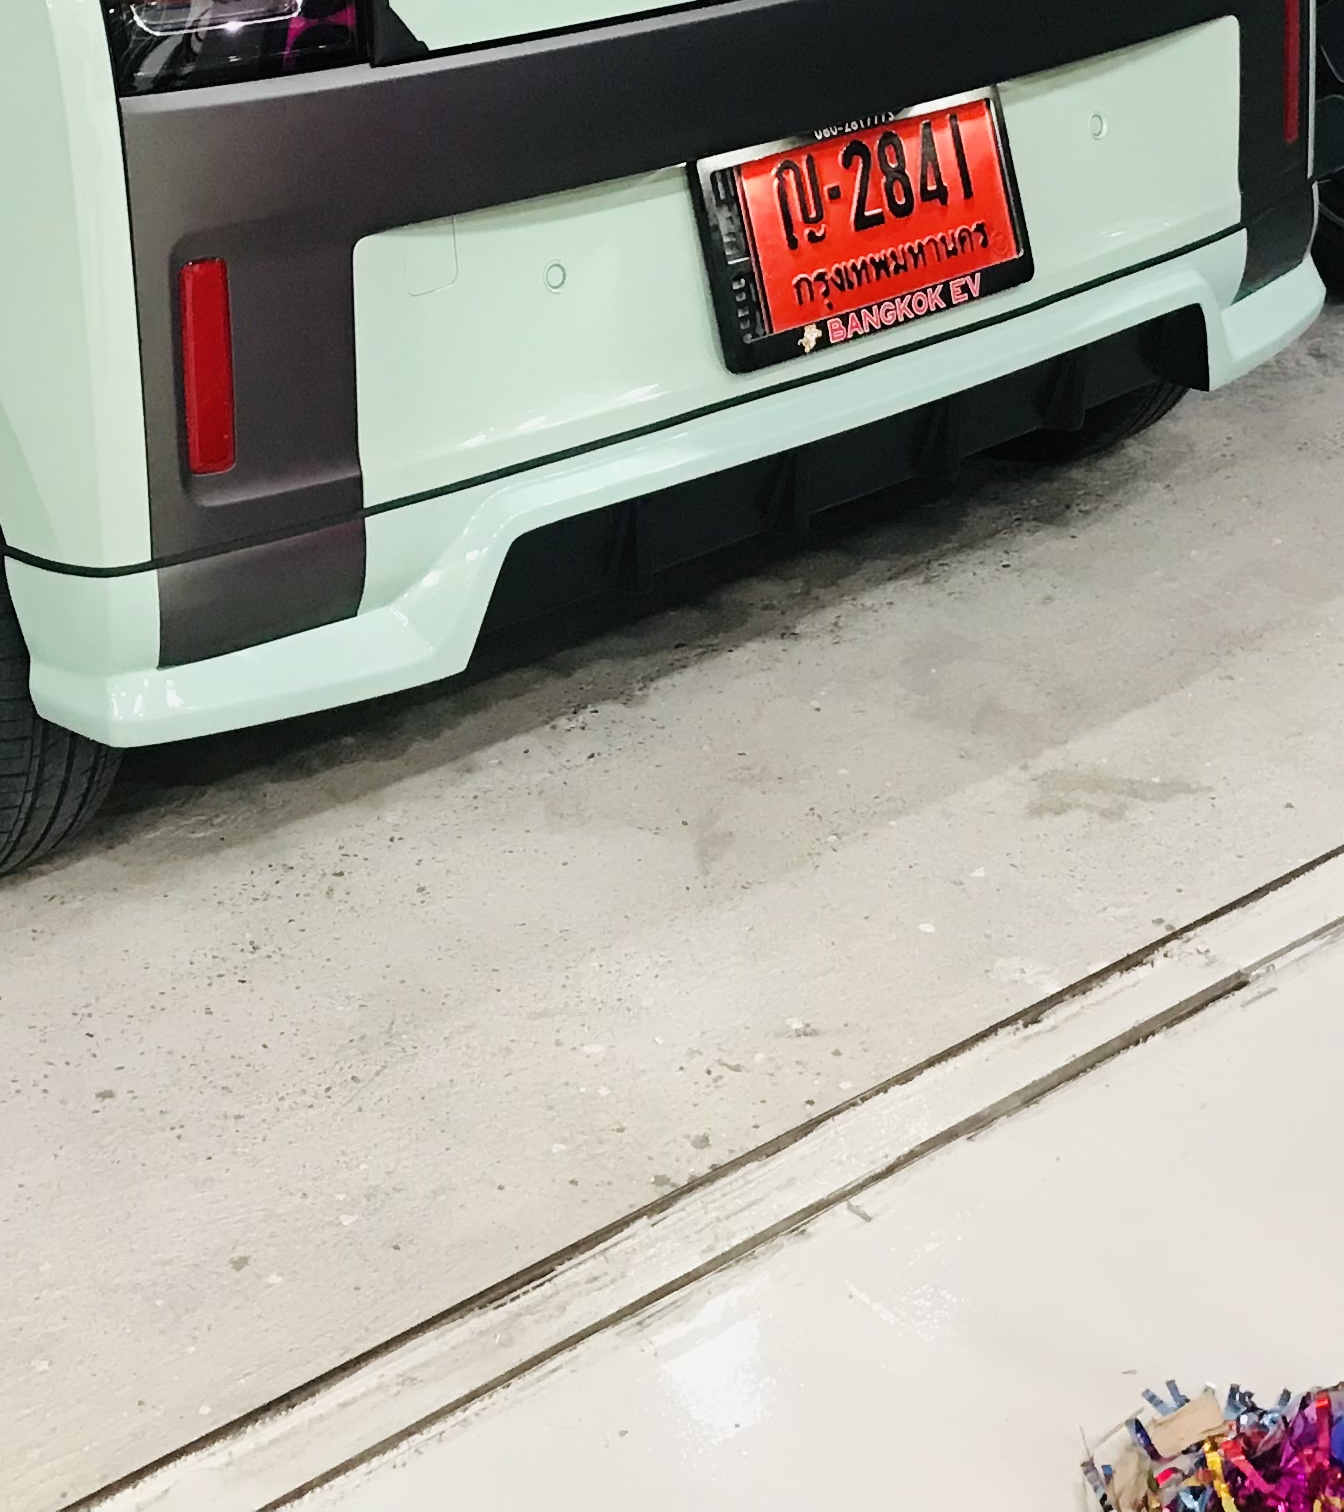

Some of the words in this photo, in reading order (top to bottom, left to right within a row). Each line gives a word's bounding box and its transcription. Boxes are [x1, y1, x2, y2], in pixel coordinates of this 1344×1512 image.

[772, 113, 974, 251] ญ-2841
[792, 220, 989, 310] กรุงเทพมหานคร
[827, 284, 947, 344] BANGKOK
[949, 272, 982, 306] EV
